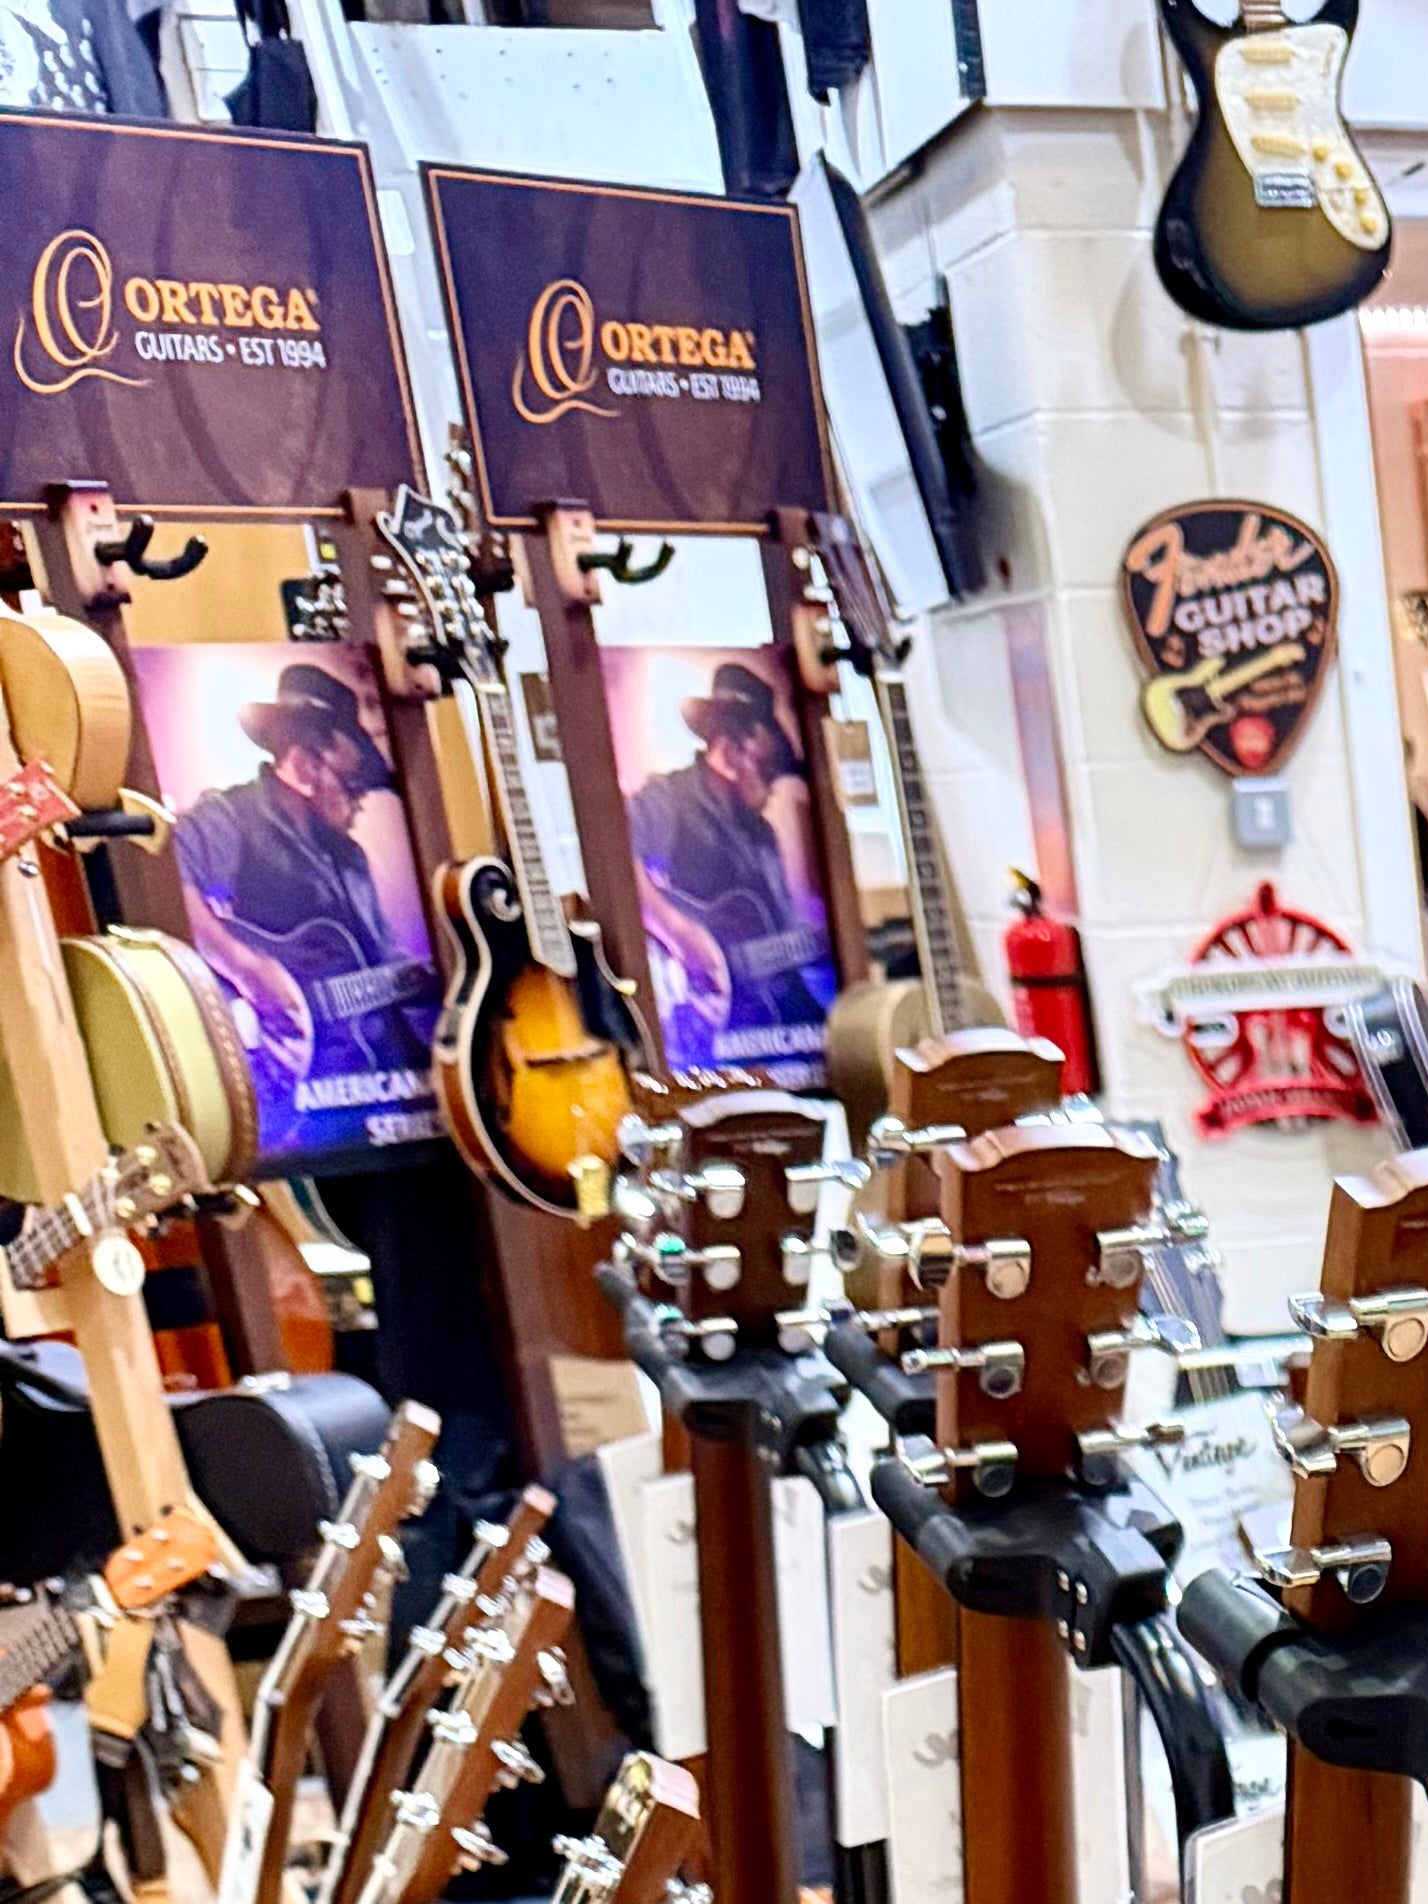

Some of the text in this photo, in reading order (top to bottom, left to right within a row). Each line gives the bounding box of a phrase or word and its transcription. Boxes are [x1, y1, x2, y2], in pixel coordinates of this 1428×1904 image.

[124, 276, 320, 332] ORTEGA
[134, 331, 328, 369] GUITARS EST 1994
[601, 320, 757, 371] ORTEGA
[1126, 511, 1318, 639] Fender
[1173, 572, 1328, 633] GUITAR
[1197, 606, 1313, 660] SHOP
